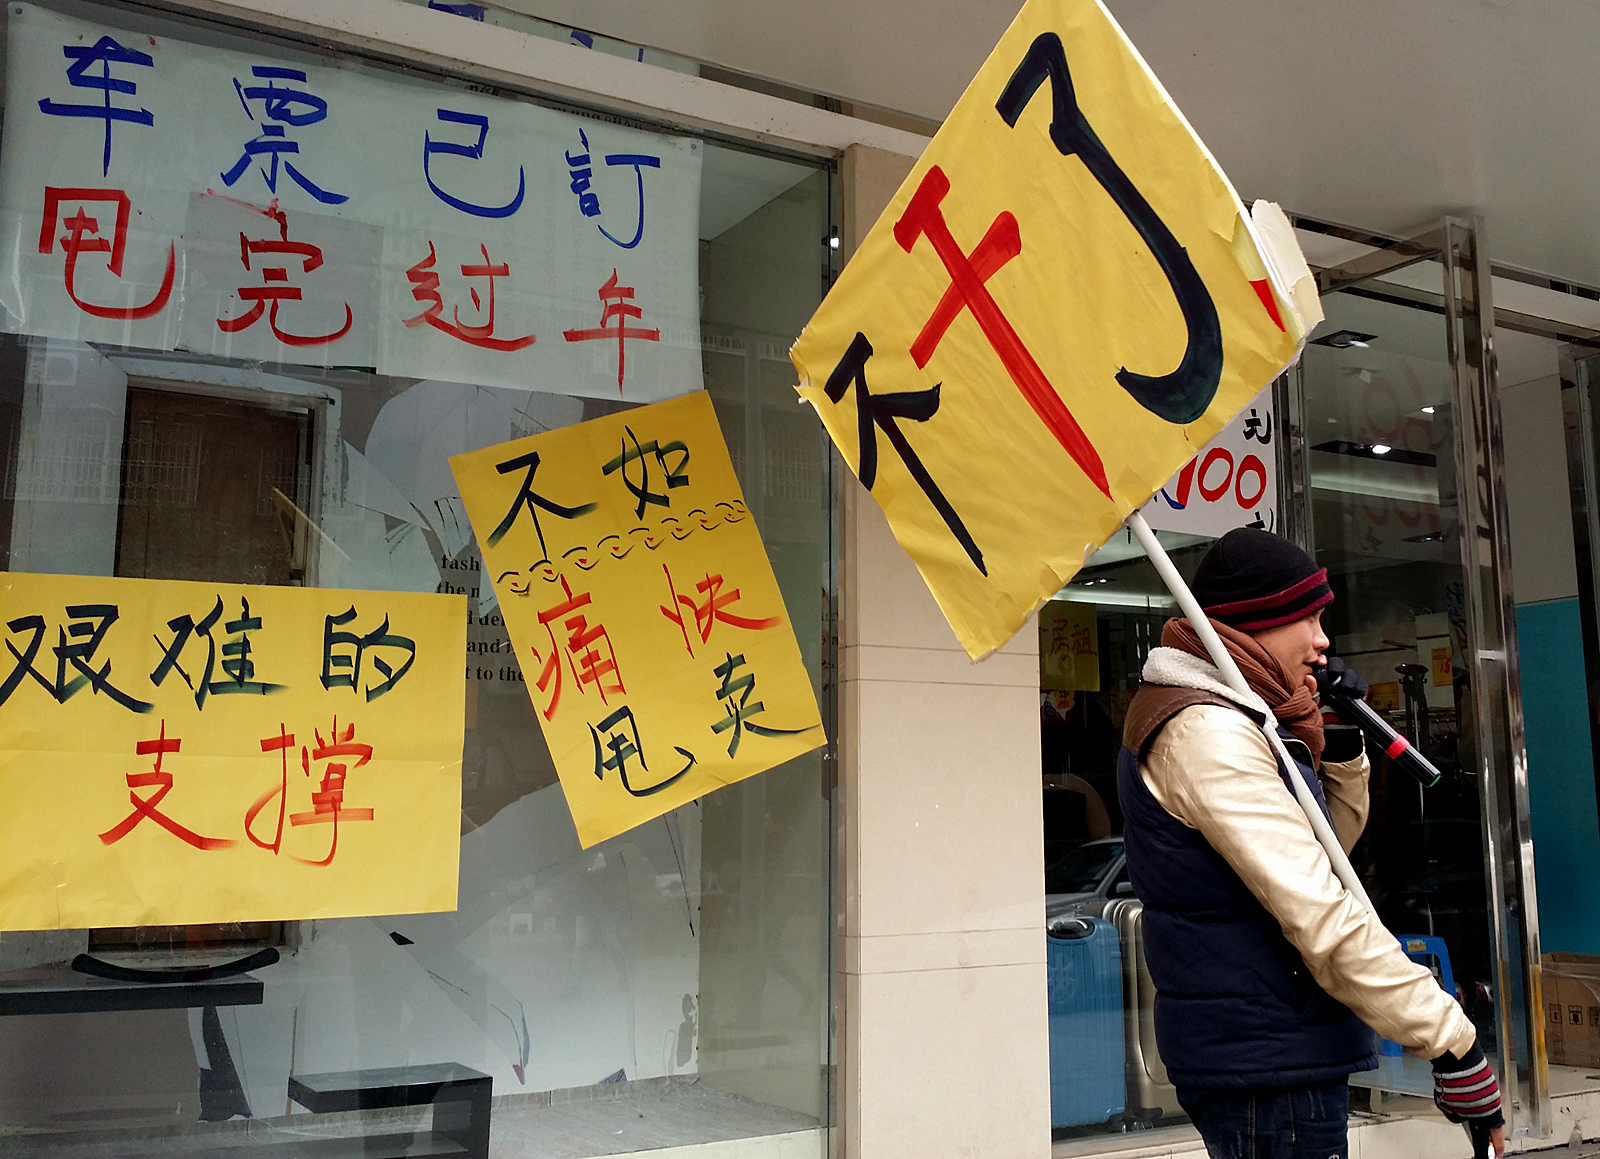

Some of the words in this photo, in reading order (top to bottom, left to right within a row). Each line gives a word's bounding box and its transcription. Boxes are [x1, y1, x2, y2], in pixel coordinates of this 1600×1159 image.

[38, 186, 661, 396] 甩完过年
[488, 424, 692, 562] 不如
[0, 595, 417, 714] 艰难的
[477, 666, 494, 681] to
[533, 563, 783, 723] 痛快
[98, 713, 375, 867] 支撑
[590, 652, 822, 798] 甩卖
